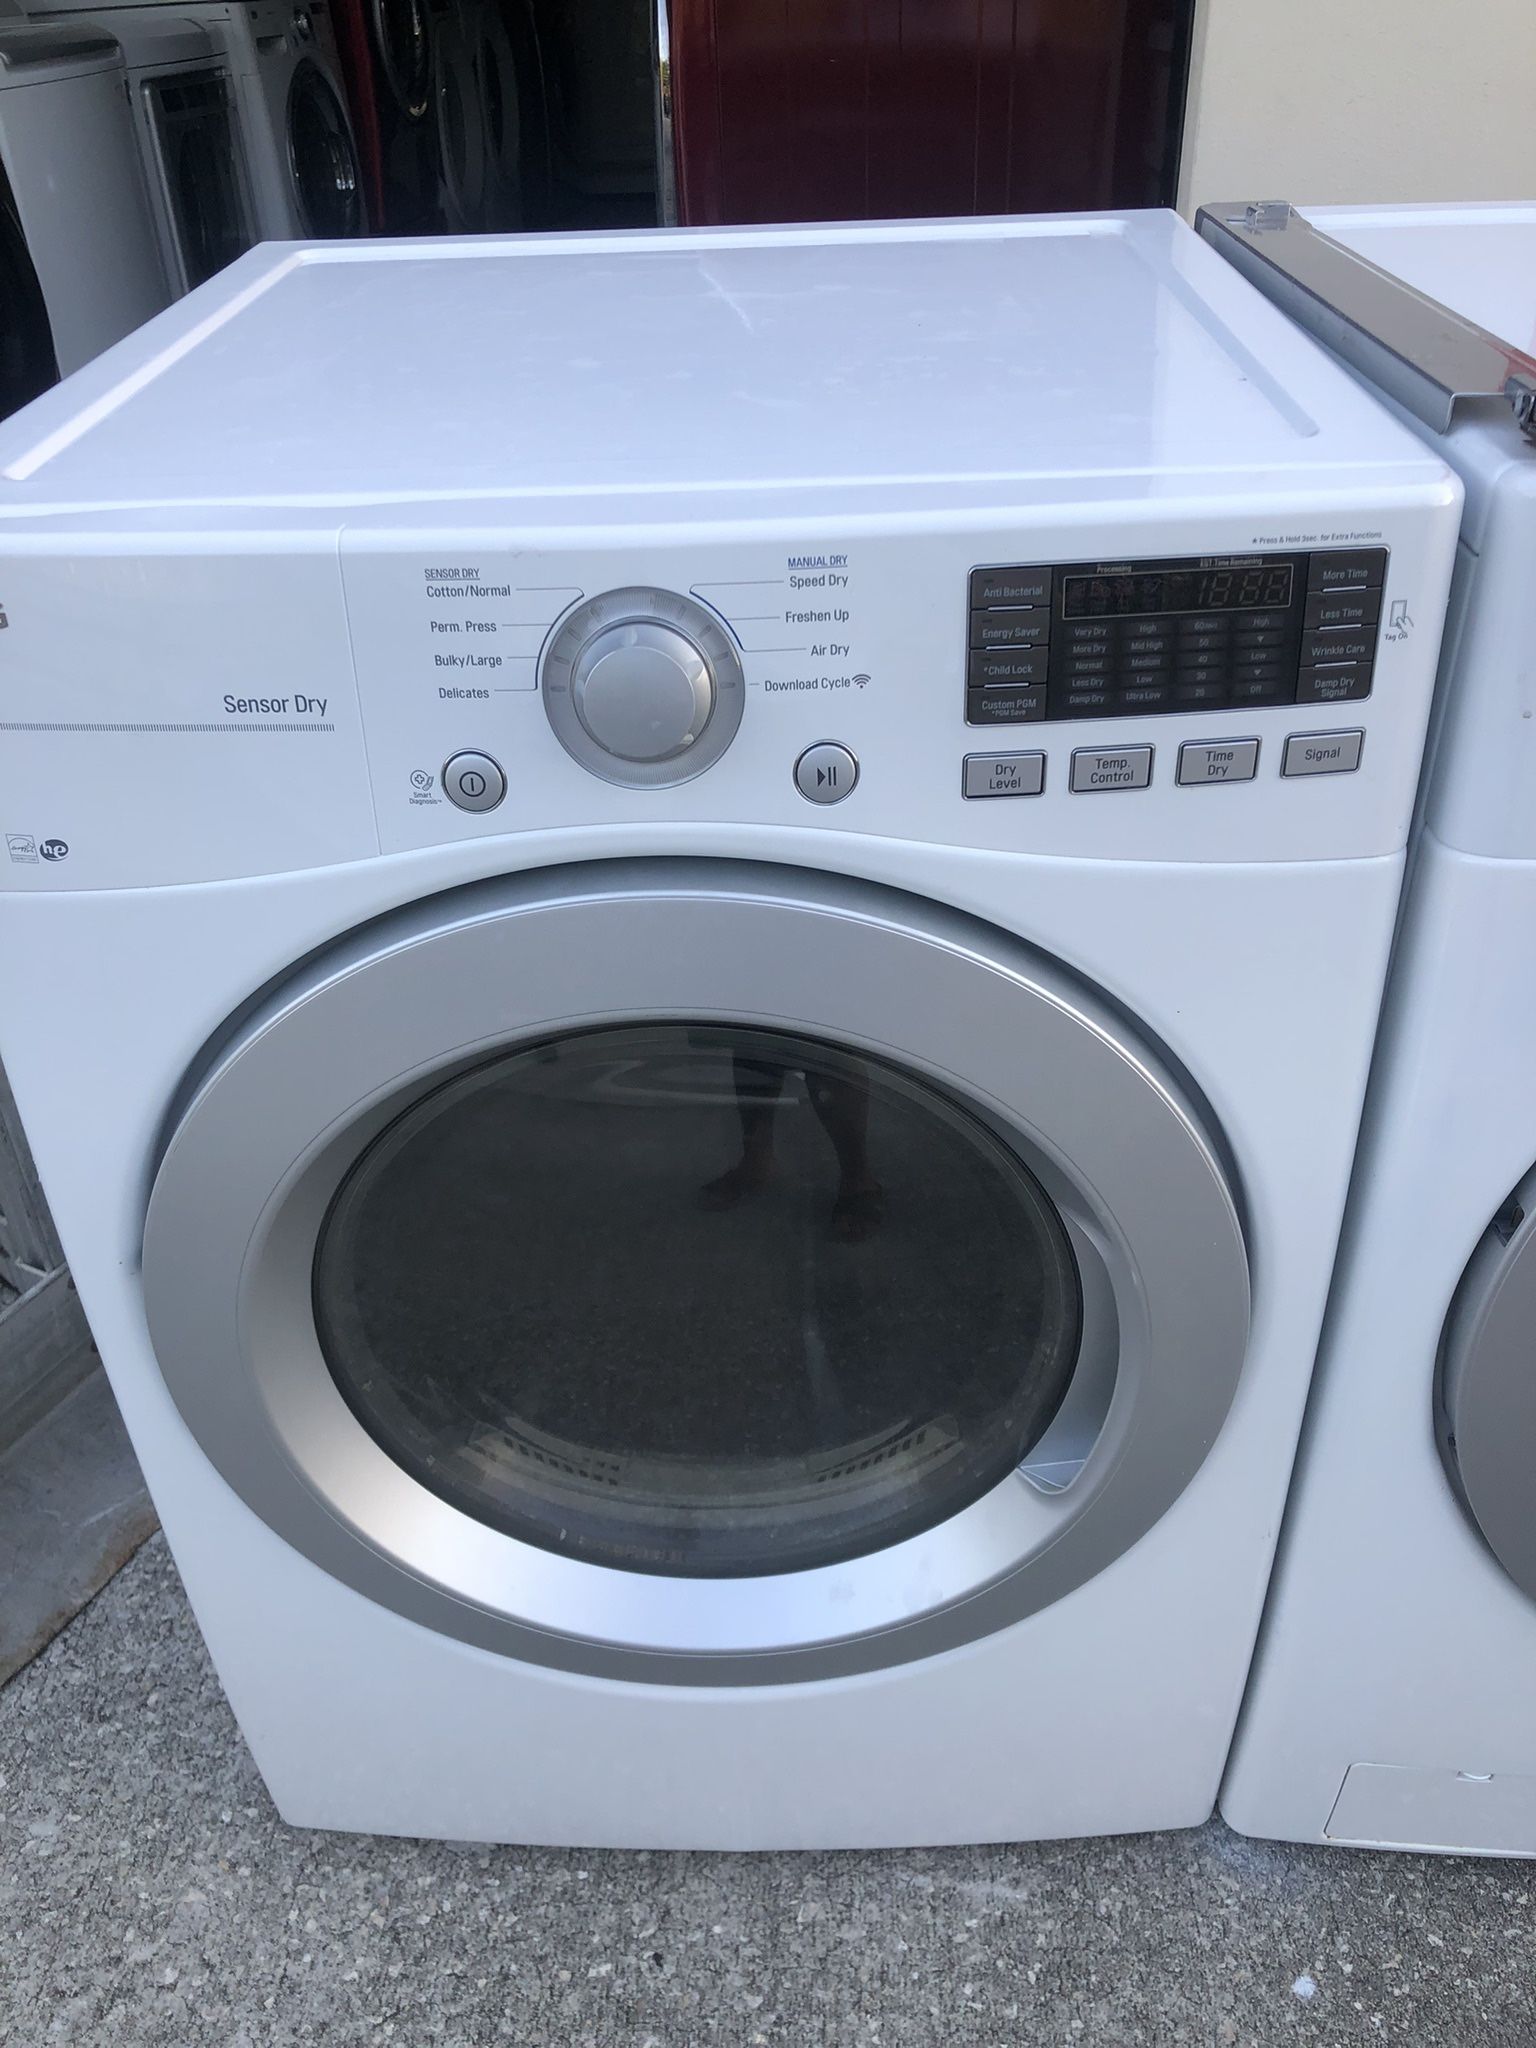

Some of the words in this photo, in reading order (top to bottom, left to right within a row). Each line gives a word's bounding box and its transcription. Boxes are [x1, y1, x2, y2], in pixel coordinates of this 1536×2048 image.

[788, 556, 828, 568] MANUAL
[829, 554, 848, 566] DRY
[425, 568, 460, 579] SENSOR
[462, 568, 480, 578] DRY
[1322, 569, 1346, 580] More
[1347, 568, 1369, 579] Time
[789, 574, 826, 590] Speed
[828, 573, 849, 588] Dry
[426, 584, 511, 598] Cotton/Normal
[983, 587, 1003, 598] Anti
[1003, 585, 1043, 597] Bacterial
[785, 610, 831, 623] Freshen
[833, 609, 850, 623] Up
[1320, 609, 1341, 620] Less
[1342, 607, 1364, 618] Time
[430, 621, 463, 632] Perm.
[465, 620, 497, 632] Press
[1075, 627, 1092, 638] Very
[1093, 626, 1107, 637] Dry
[1139, 624, 1158, 634] High
[982, 628, 1013, 640] Energy
[1014, 626, 1041, 638] Saver
[1384, 633, 1396, 642] Tag
[811, 645, 828, 657] Air
[829, 643, 850, 658] Dry
[1072, 645, 1092, 655] More
[1093, 644, 1107, 654] Dry
[1146, 640, 1164, 652] High
[1311, 645, 1345, 657] Wrinkle
[1345, 644, 1366, 655] Care
[434, 654, 503, 668] Bulky/Large
[1250, 651, 1267, 661] Low
[1011, 663, 1033, 675] Lock
[1075, 661, 1104, 672] Normal
[764, 678, 820, 693] Download
[820, 676, 852, 691] Cycle
[1071, 679, 1090, 688] Less
[1090, 677, 1105, 688] Dry
[1136, 675, 1153, 684] Low
[1314, 679, 1339, 690] Damp
[1339, 677, 1356, 688] Dry
[438, 686, 491, 699] Delicates
[1069, 695, 1091, 705] Damp
[1091, 693, 1105, 704] Dry
[1144, 690, 1161, 700] Low
[1321, 687, 1348, 698] Signal
[223, 694, 289, 714] Sensor
[294, 694, 328, 717] Dry
[981, 700, 1015, 711] Custom
[1016, 698, 1037, 709] PGM
[1010, 707, 1027, 717] Save
[1205, 750, 1234, 763] Time
[1304, 746, 1341, 762] Signal
[995, 762, 1017, 778] Dry
[1095, 757, 1131, 771] Temp.
[1090, 770, 1134, 784] Control
[1207, 764, 1229, 778] Dry
[989, 776, 1021, 790] Level
[413, 791, 432, 799] Smart
